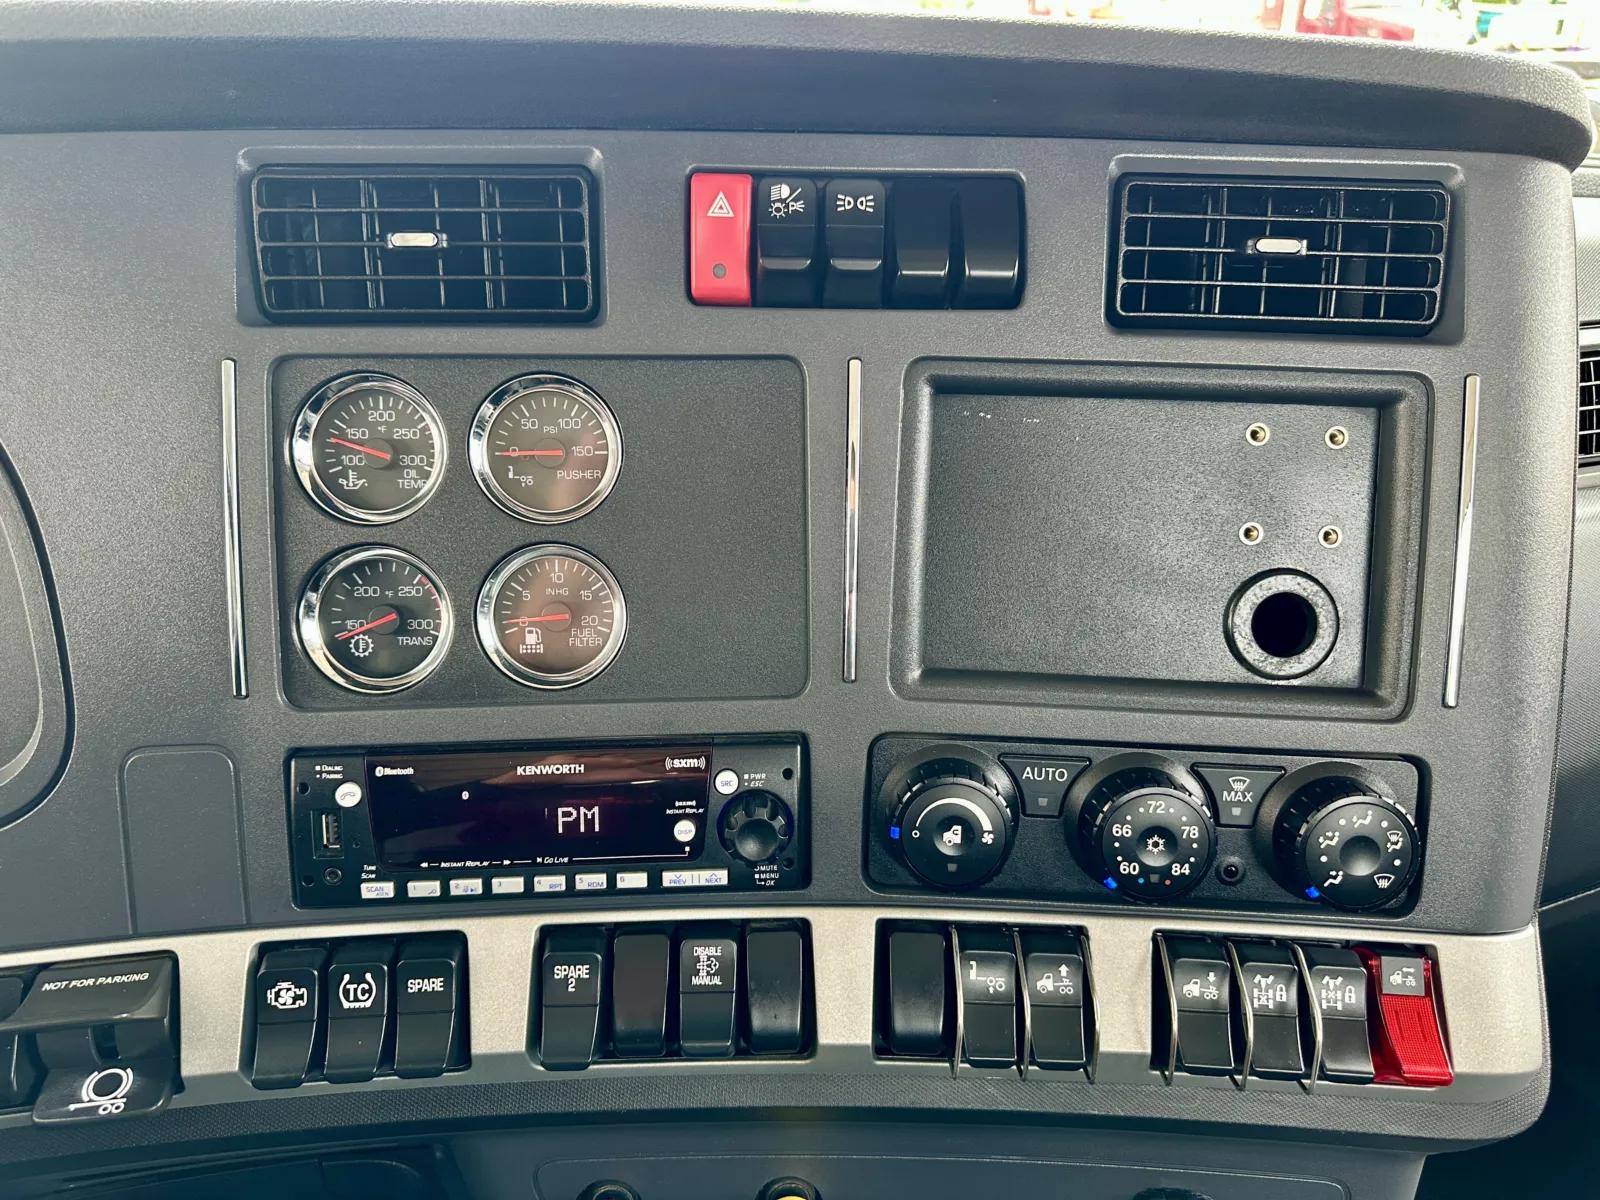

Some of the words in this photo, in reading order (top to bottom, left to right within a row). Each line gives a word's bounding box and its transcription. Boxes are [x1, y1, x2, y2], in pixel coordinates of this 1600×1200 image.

[368, 411, 395, 421] 200
[521, 418, 538, 430] 50
[558, 418, 581, 429] 100
[346, 428, 368, 439] 150
[394, 429, 420, 439] 250
[572, 446, 593, 457] 150
[341, 455, 365, 466] 100
[400, 455, 426, 466] 300
[404, 470, 421, 478] OIL
[557, 470, 601, 480] PUSHER
[397, 480, 428, 489] TEMP
[550, 573, 564, 583] 10
[354, 586, 380, 597] 200
[398, 586, 423, 597] 250
[522, 590, 530, 600] 5
[580, 590, 592, 600] 15
[344, 620, 366, 630] 150
[408, 619, 433, 630] 300
[581, 616, 598, 626] 20
[571, 628, 598, 637] FUEL
[397, 637, 433, 646] TRANS
[569, 638, 603, 647] FILTER
[384, 767, 414, 775] Bluetooth
[516, 764, 584, 776] KENWORTH
[1022, 766, 1067, 781] AUTO
[1222, 791, 1252, 802] MAX
[1147, 801, 1165, 814] 72
[558, 806, 600, 834] PM
[1112, 824, 1132, 837] 66
[1181, 826, 1199, 839] 78
[1120, 862, 1139, 875] 60
[1171, 863, 1190, 876] 84
[693, 947, 722, 956] DISABLE
[554, 964, 590, 979] SPARE
[41, 981, 68, 992] NOT
[69, 978, 95, 988] FOR
[96, 972, 150, 985] PARKING
[407, 978, 444, 993] SPARE
[568, 978, 576, 992] 2
[692, 975, 722, 985] MANUAL
[346, 983, 370, 1000] TC
